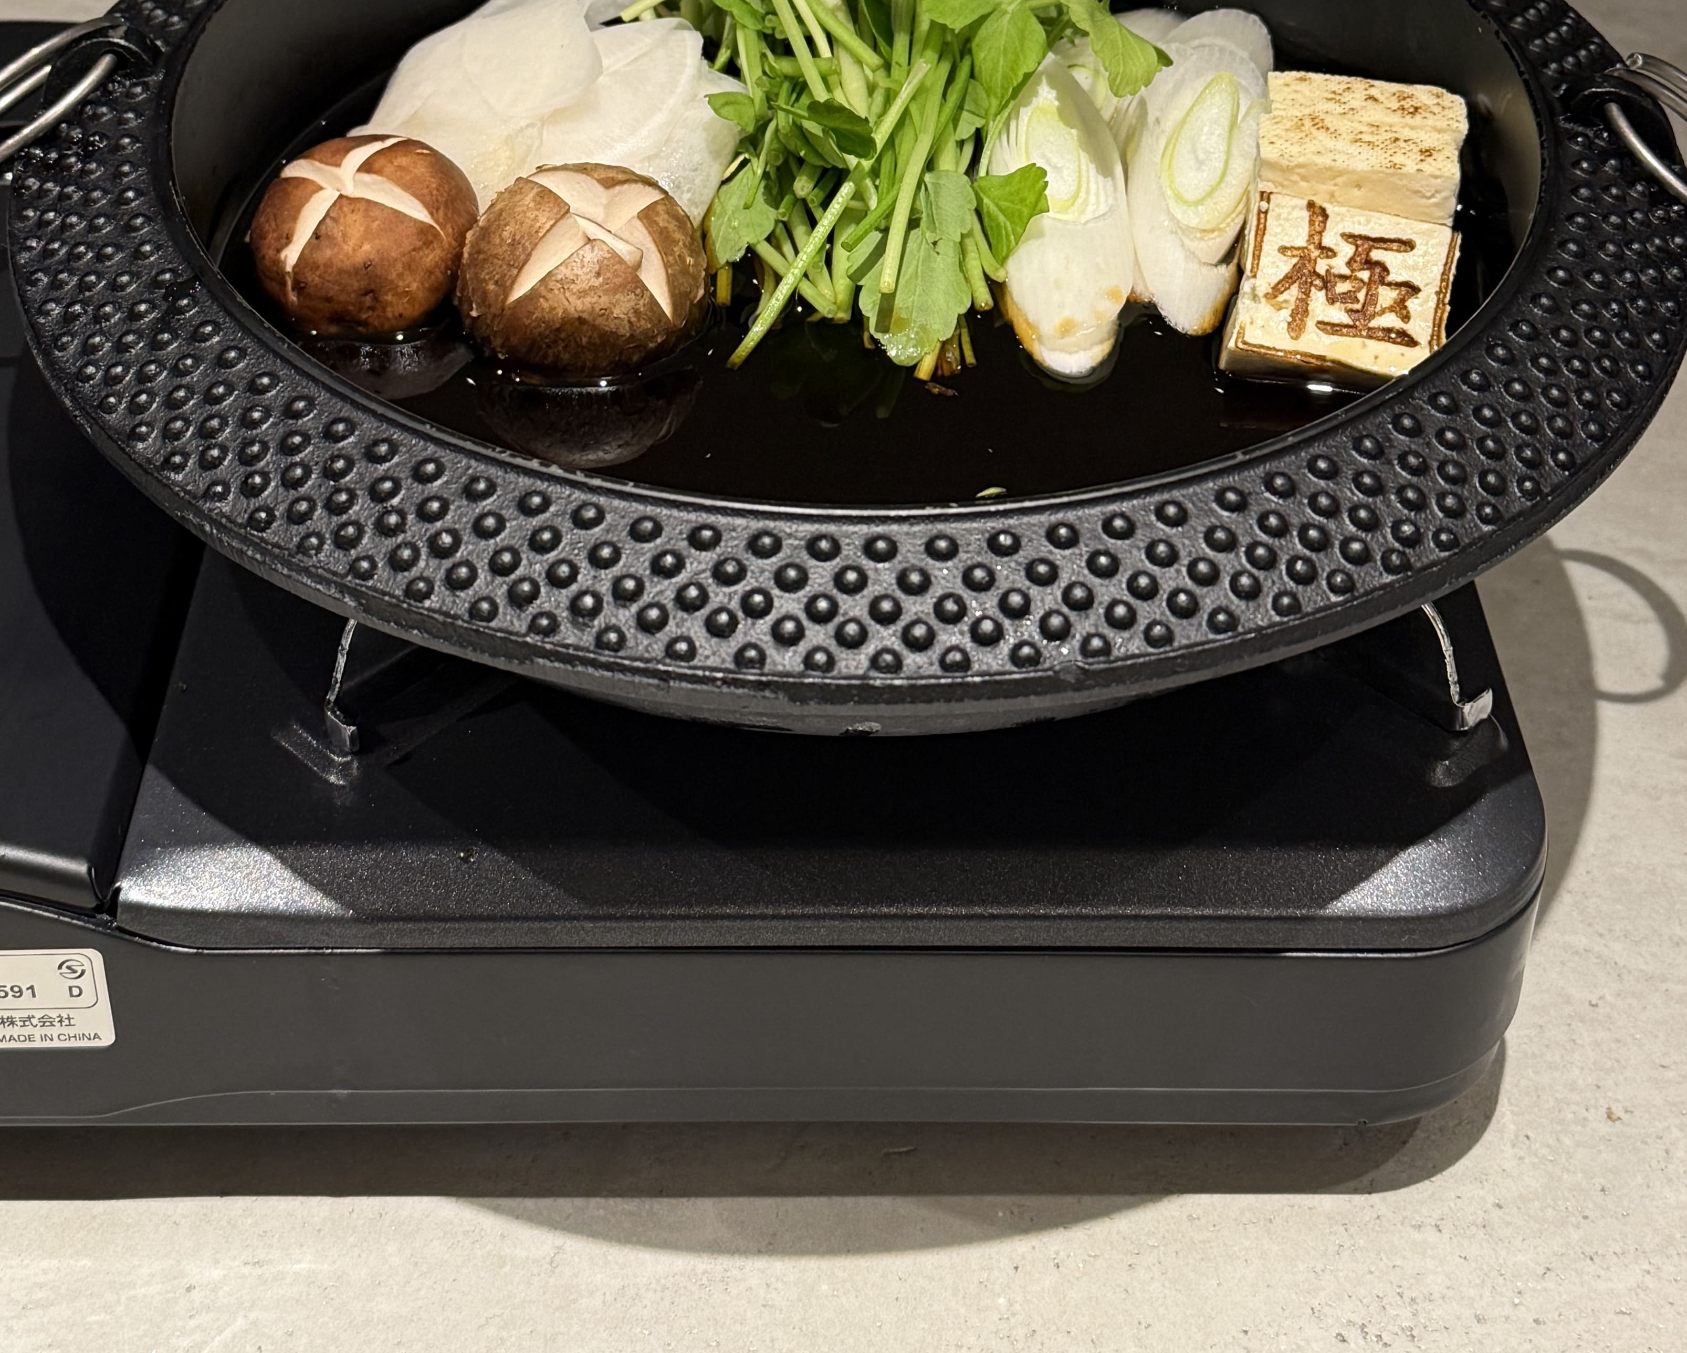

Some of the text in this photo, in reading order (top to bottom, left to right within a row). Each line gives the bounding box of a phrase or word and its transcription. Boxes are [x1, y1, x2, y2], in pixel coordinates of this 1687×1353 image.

[1263, 199, 1422, 348] 極
[0, 984, 84, 999] 591 D
[0, 1014, 76, 1028] 株式会社
[0, 1032, 102, 1043] MADE IN CHINA
